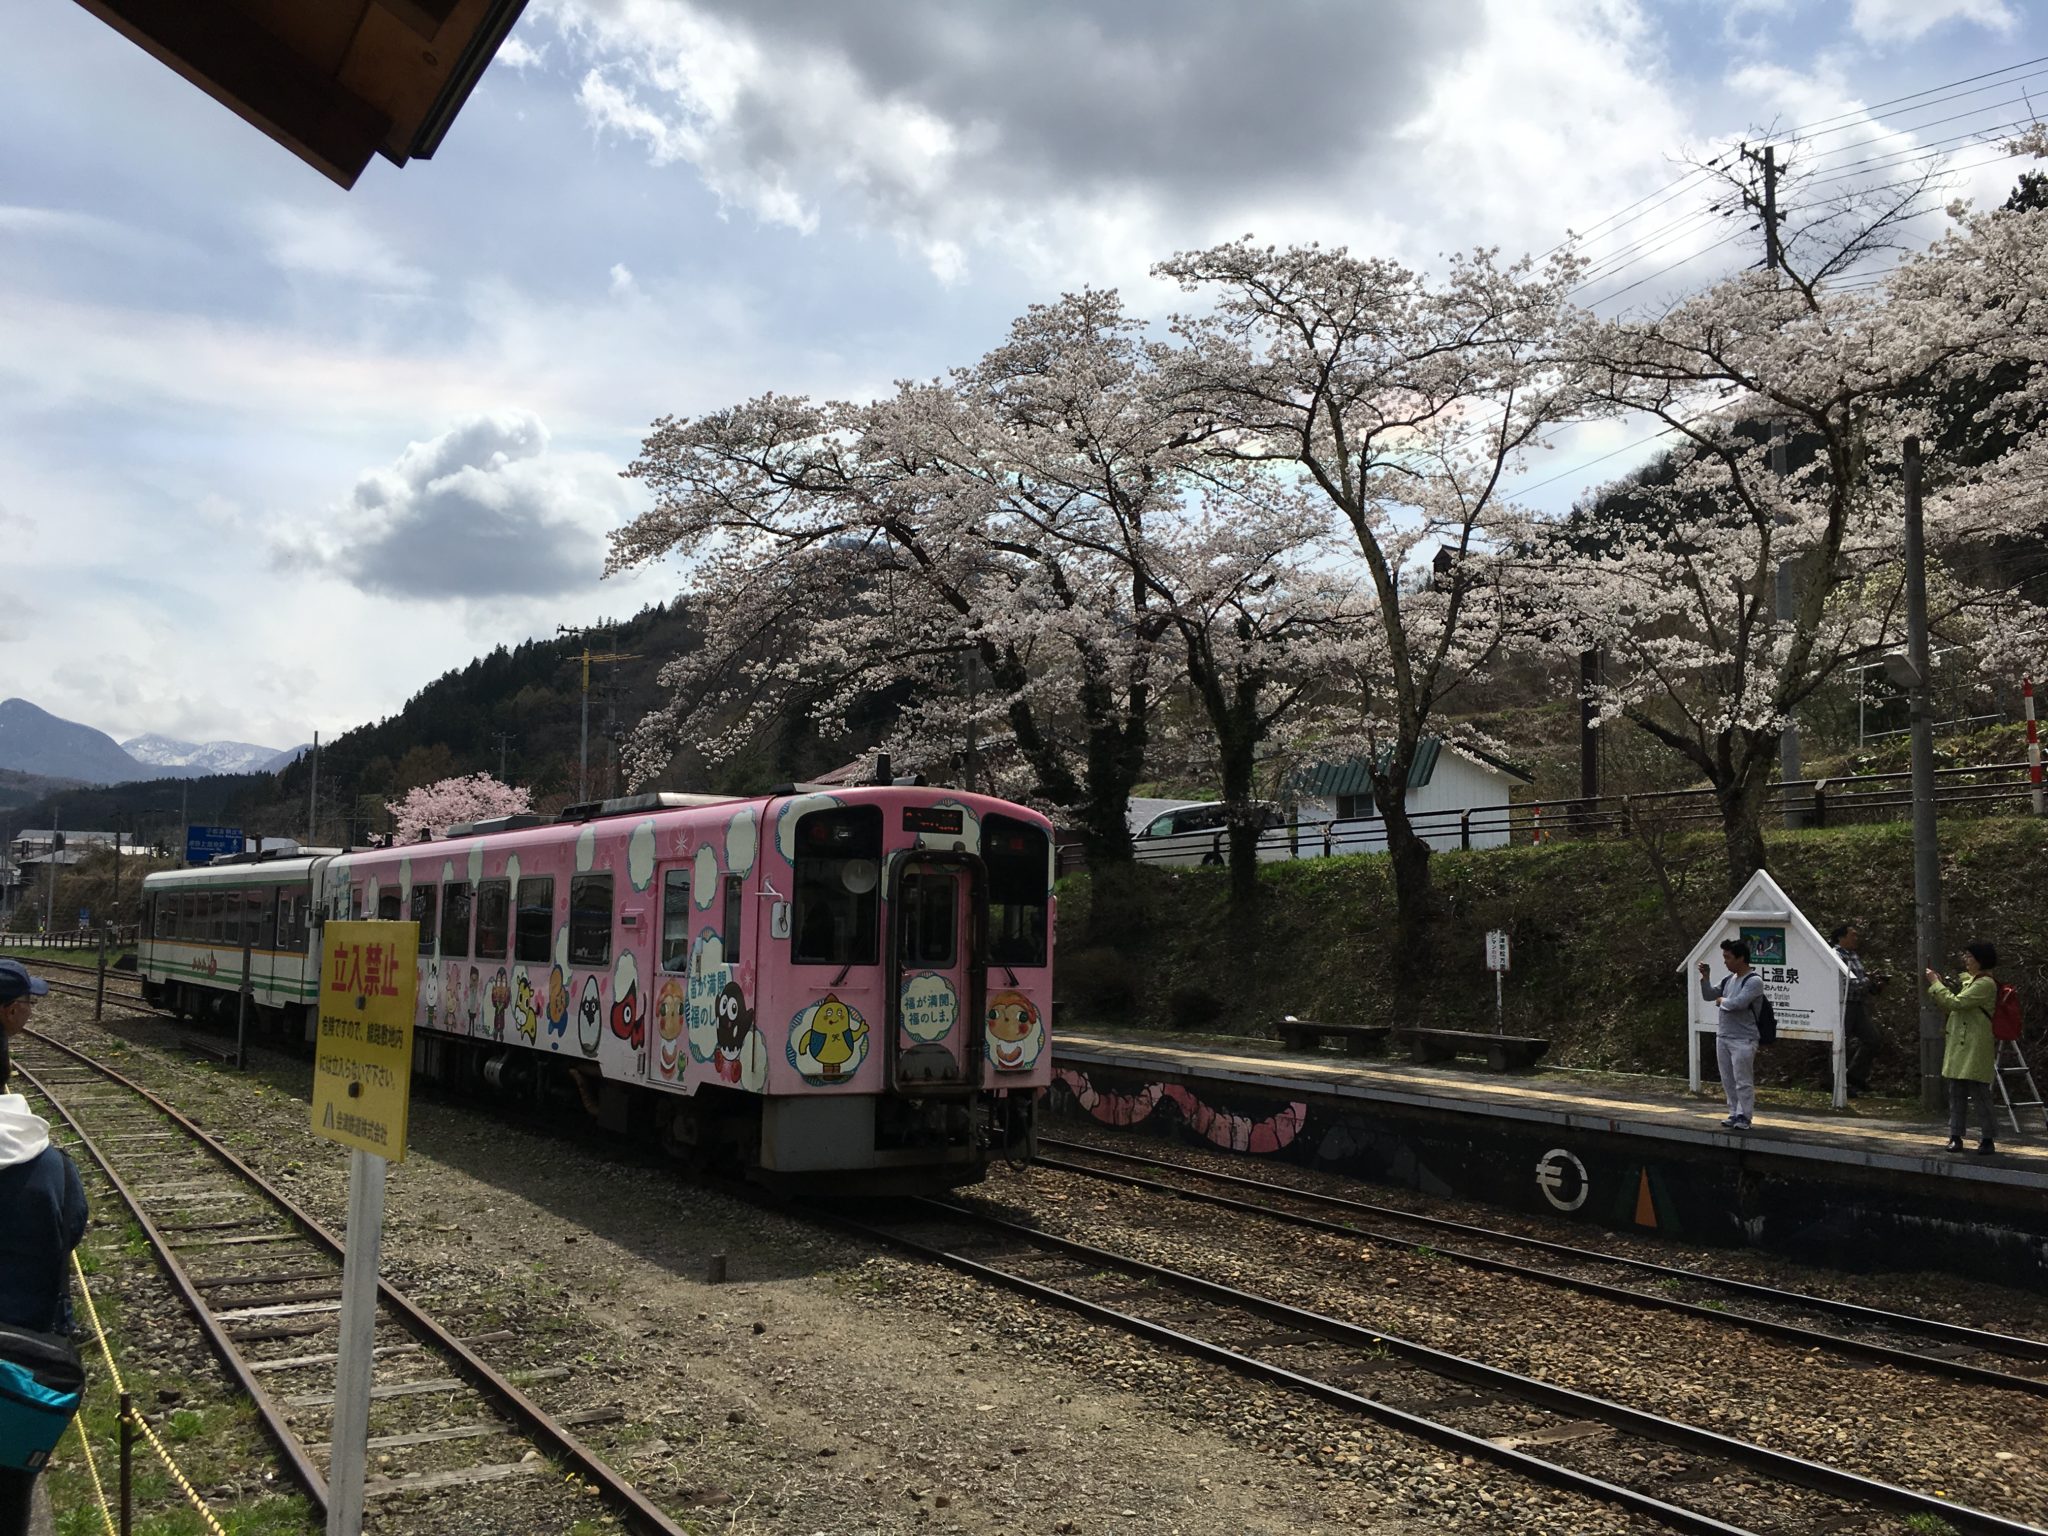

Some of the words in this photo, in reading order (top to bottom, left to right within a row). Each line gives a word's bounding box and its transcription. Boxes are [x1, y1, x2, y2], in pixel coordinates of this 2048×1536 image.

[331, 941, 399, 997] 立入禁止
[1751, 967, 1799, 984] 上温泉
[904, 994, 953, 1010] 福が満開、
